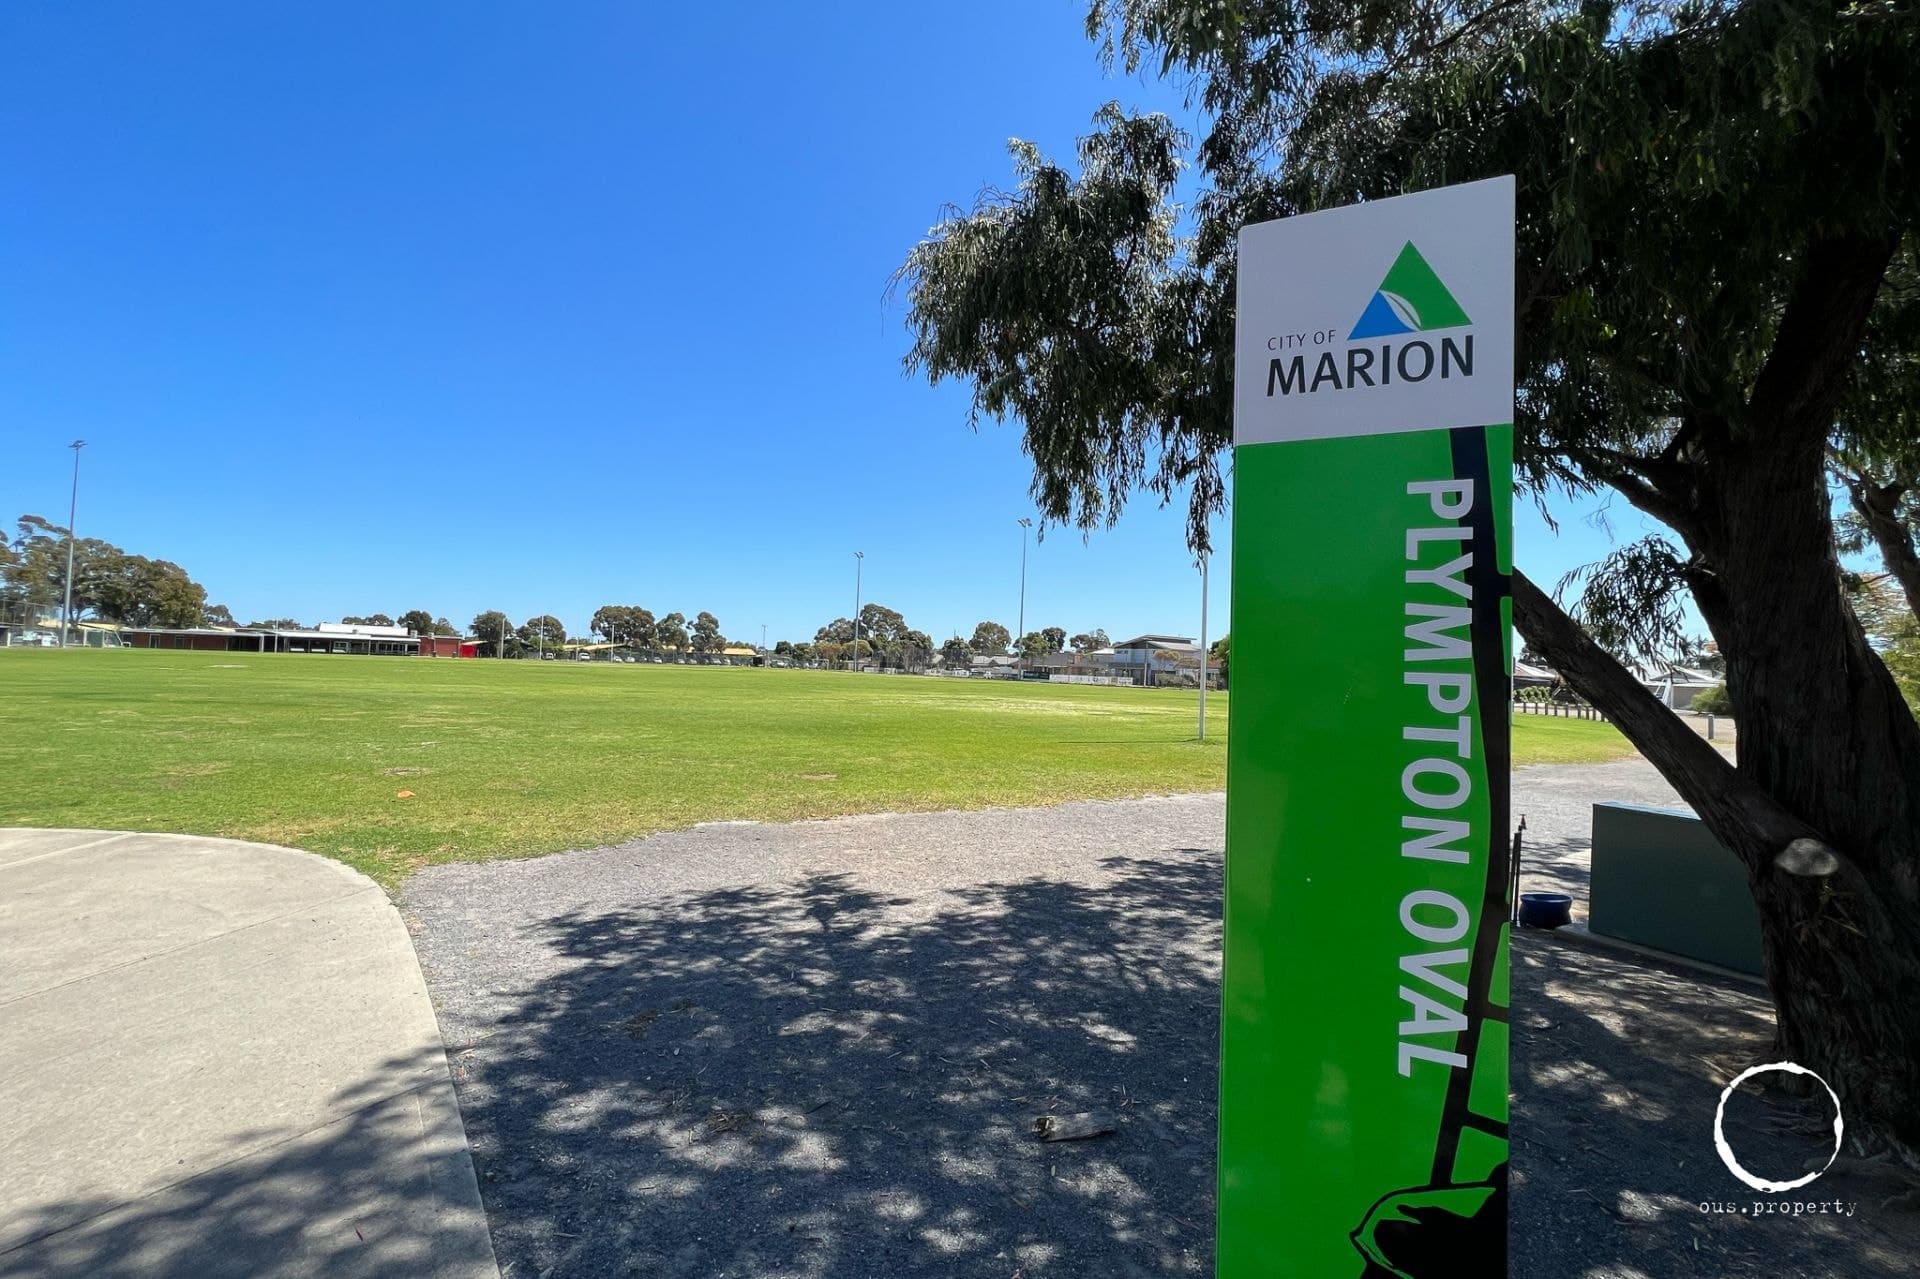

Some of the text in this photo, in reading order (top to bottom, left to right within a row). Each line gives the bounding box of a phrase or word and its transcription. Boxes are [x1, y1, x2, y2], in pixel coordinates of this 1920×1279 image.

[1266, 334, 1474, 397] MARION
[1267, 329, 1337, 351] CITY OF
[1398, 478, 1474, 1077] PLYMPTON OVAL
